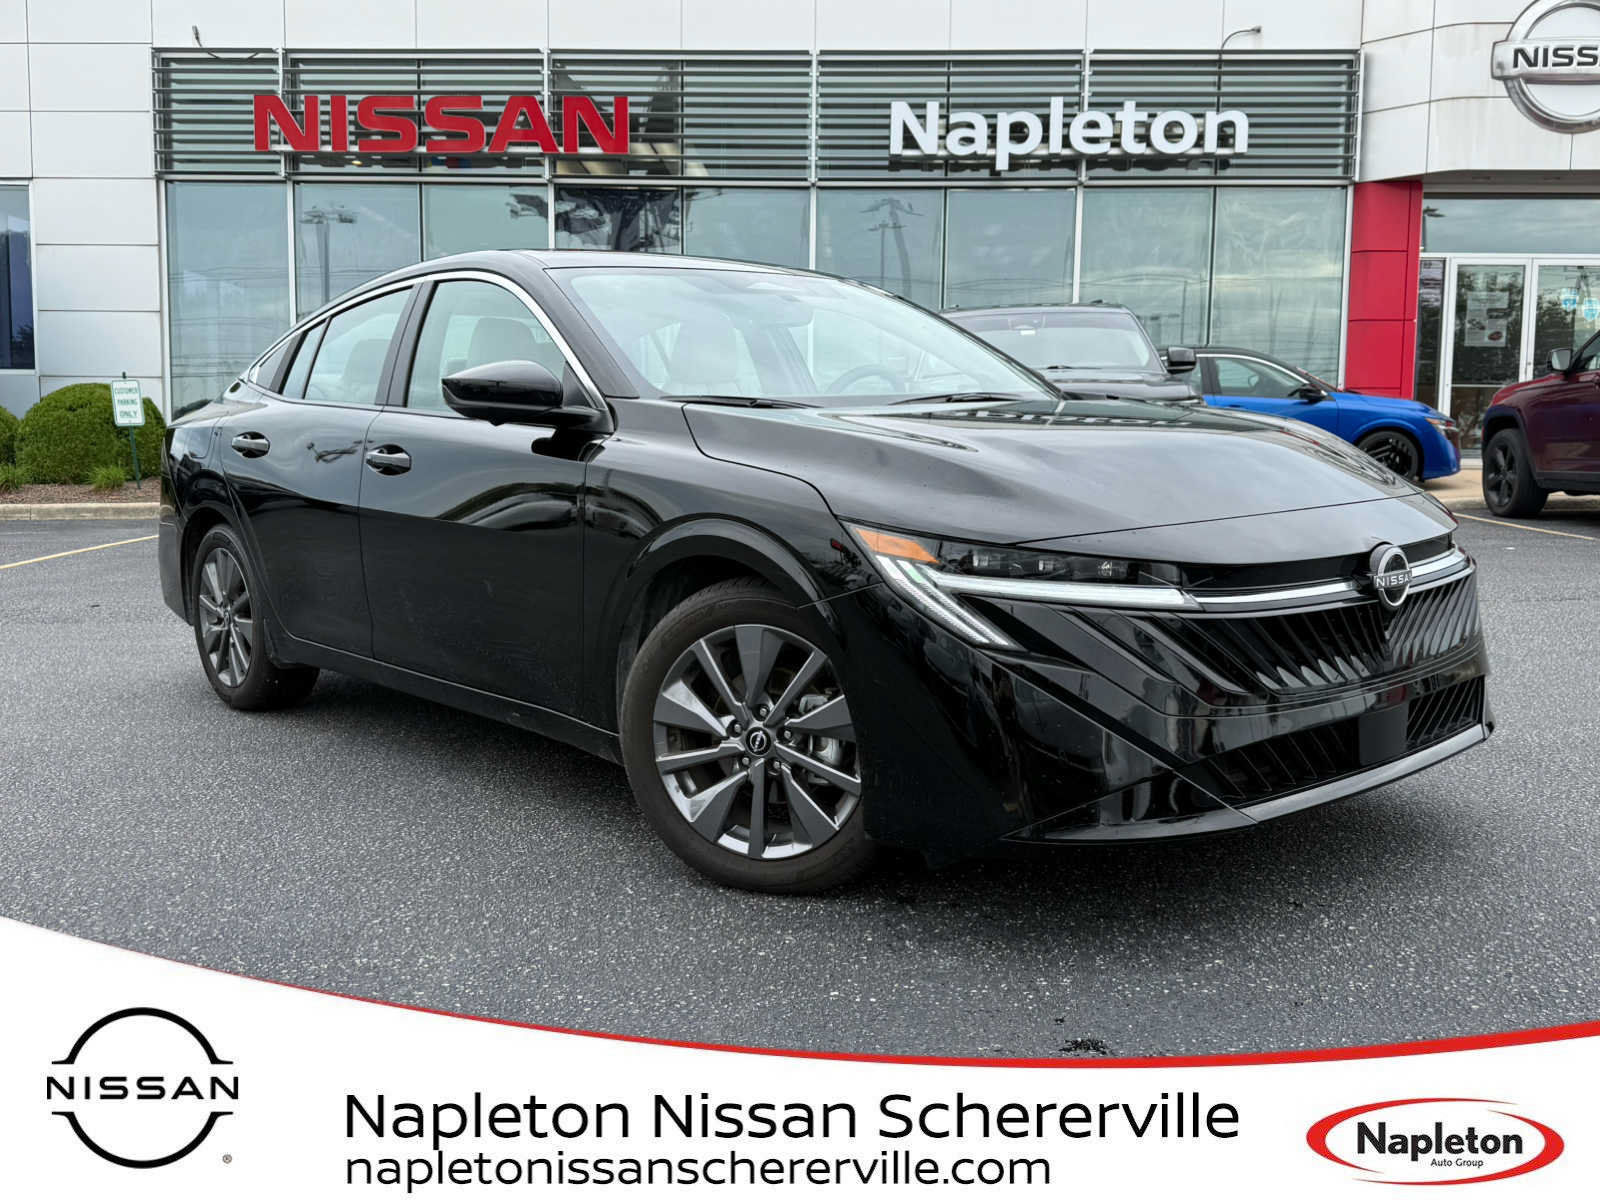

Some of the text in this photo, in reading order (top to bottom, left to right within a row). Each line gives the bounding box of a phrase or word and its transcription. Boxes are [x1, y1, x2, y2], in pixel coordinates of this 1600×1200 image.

[1512, 46, 1600, 68] NISS
[253, 95, 630, 154] NISSAN
[889, 96, 1250, 171] Napleton
[119, 410, 137, 418] ONLY
